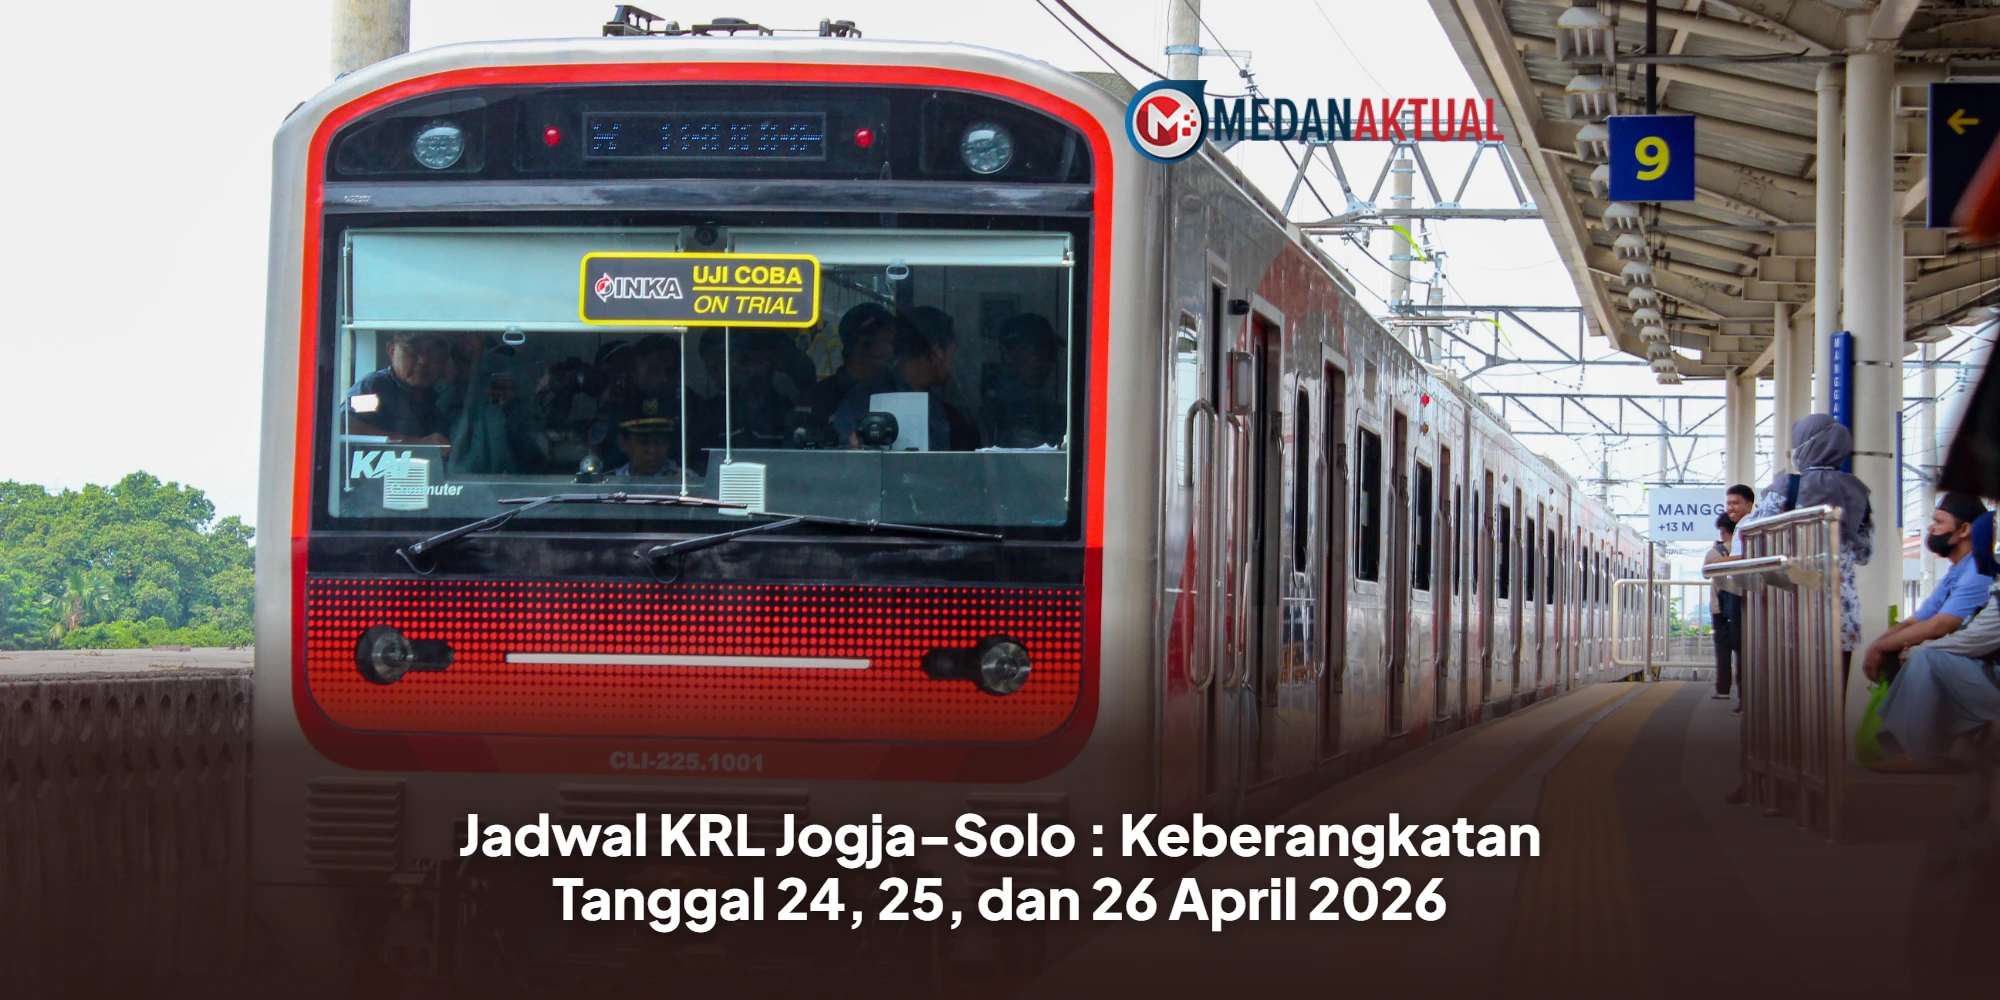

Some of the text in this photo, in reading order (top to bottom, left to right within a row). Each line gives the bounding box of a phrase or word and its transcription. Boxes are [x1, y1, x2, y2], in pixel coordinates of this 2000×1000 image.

[1634, 136, 1671, 181] 9
[692, 265, 803, 285] UJI COBA
[614, 276, 683, 300] INKA
[693, 295, 798, 315] ON TRIAL
[350, 450, 412, 479] KAI
[1658, 503, 1725, 516] MANGG
[1658, 521, 1694, 532] +13 M
[609, 750, 764, 772] CLI-225.1001
